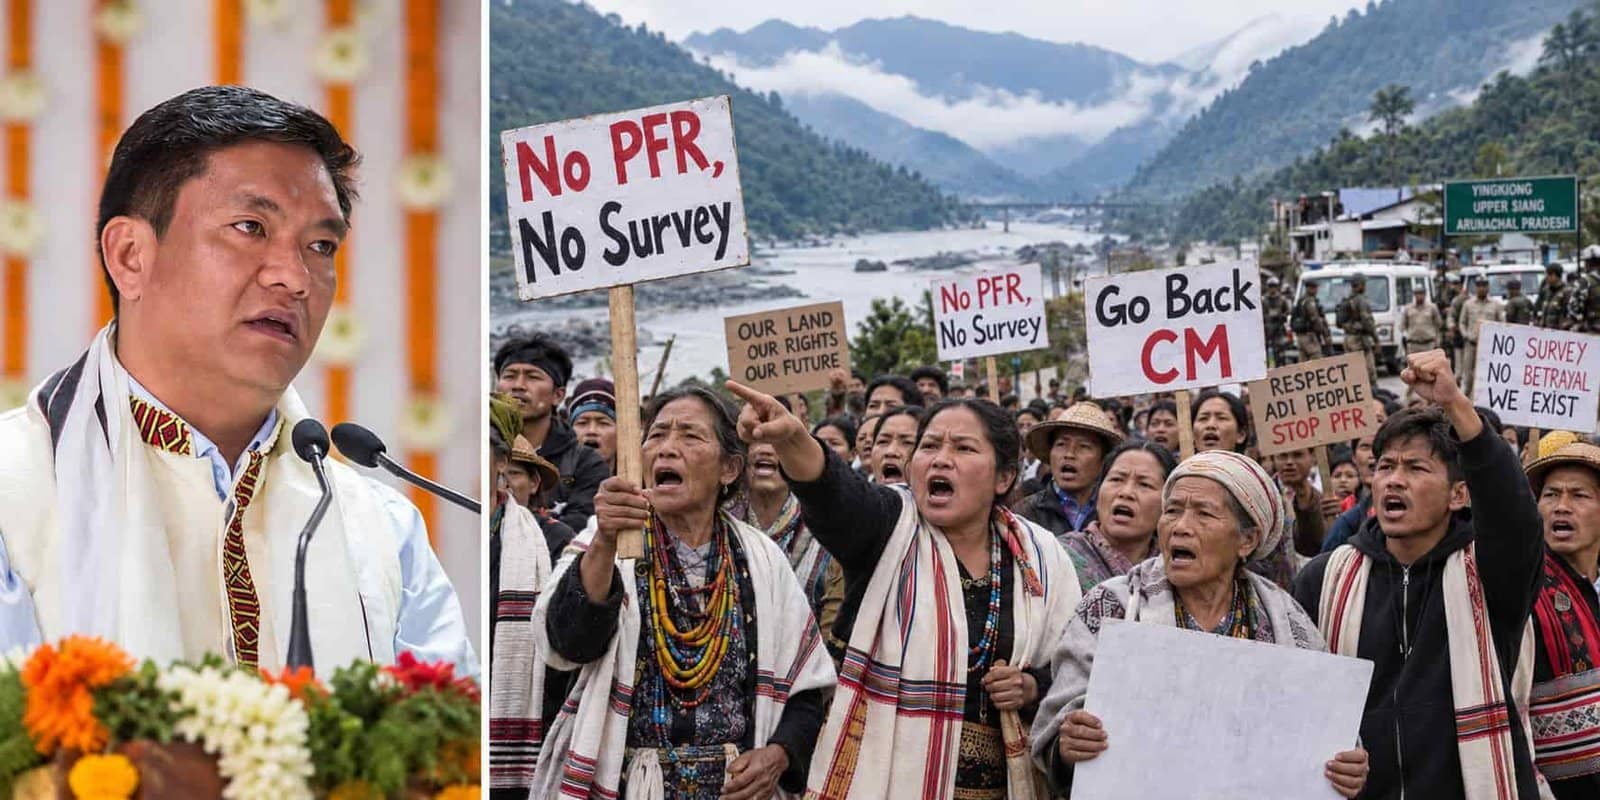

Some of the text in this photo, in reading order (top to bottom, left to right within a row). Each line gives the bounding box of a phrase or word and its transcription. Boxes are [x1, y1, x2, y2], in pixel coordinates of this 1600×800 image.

[516, 110, 725, 202] No PFR,
[1472, 183, 1533, 196] YINGKIONG
[1473, 199, 1544, 213] UPPER SIANG
[1456, 216, 1570, 231] ARUNACHAL PRADESH
[518, 201, 731, 284] No Survey
[940, 273, 1032, 314] No PFR,
[1095, 268, 1256, 327] Go Back
[738, 312, 833, 341] OUR LAND
[940, 315, 1041, 349] No Survey
[747, 331, 838, 360] OUR RIGHTS
[1141, 324, 1232, 384] CM
[1492, 333, 1588, 366] NO SURVEY
[745, 353, 840, 381] OUR FUTURE
[1270, 363, 1348, 397] RESPECT
[1488, 361, 1591, 392] NO BETRAYAL
[1265, 384, 1364, 421] ADI PEOPLE
[1488, 387, 1579, 417] WE EXIST
[1272, 407, 1367, 445] STOP PFR
